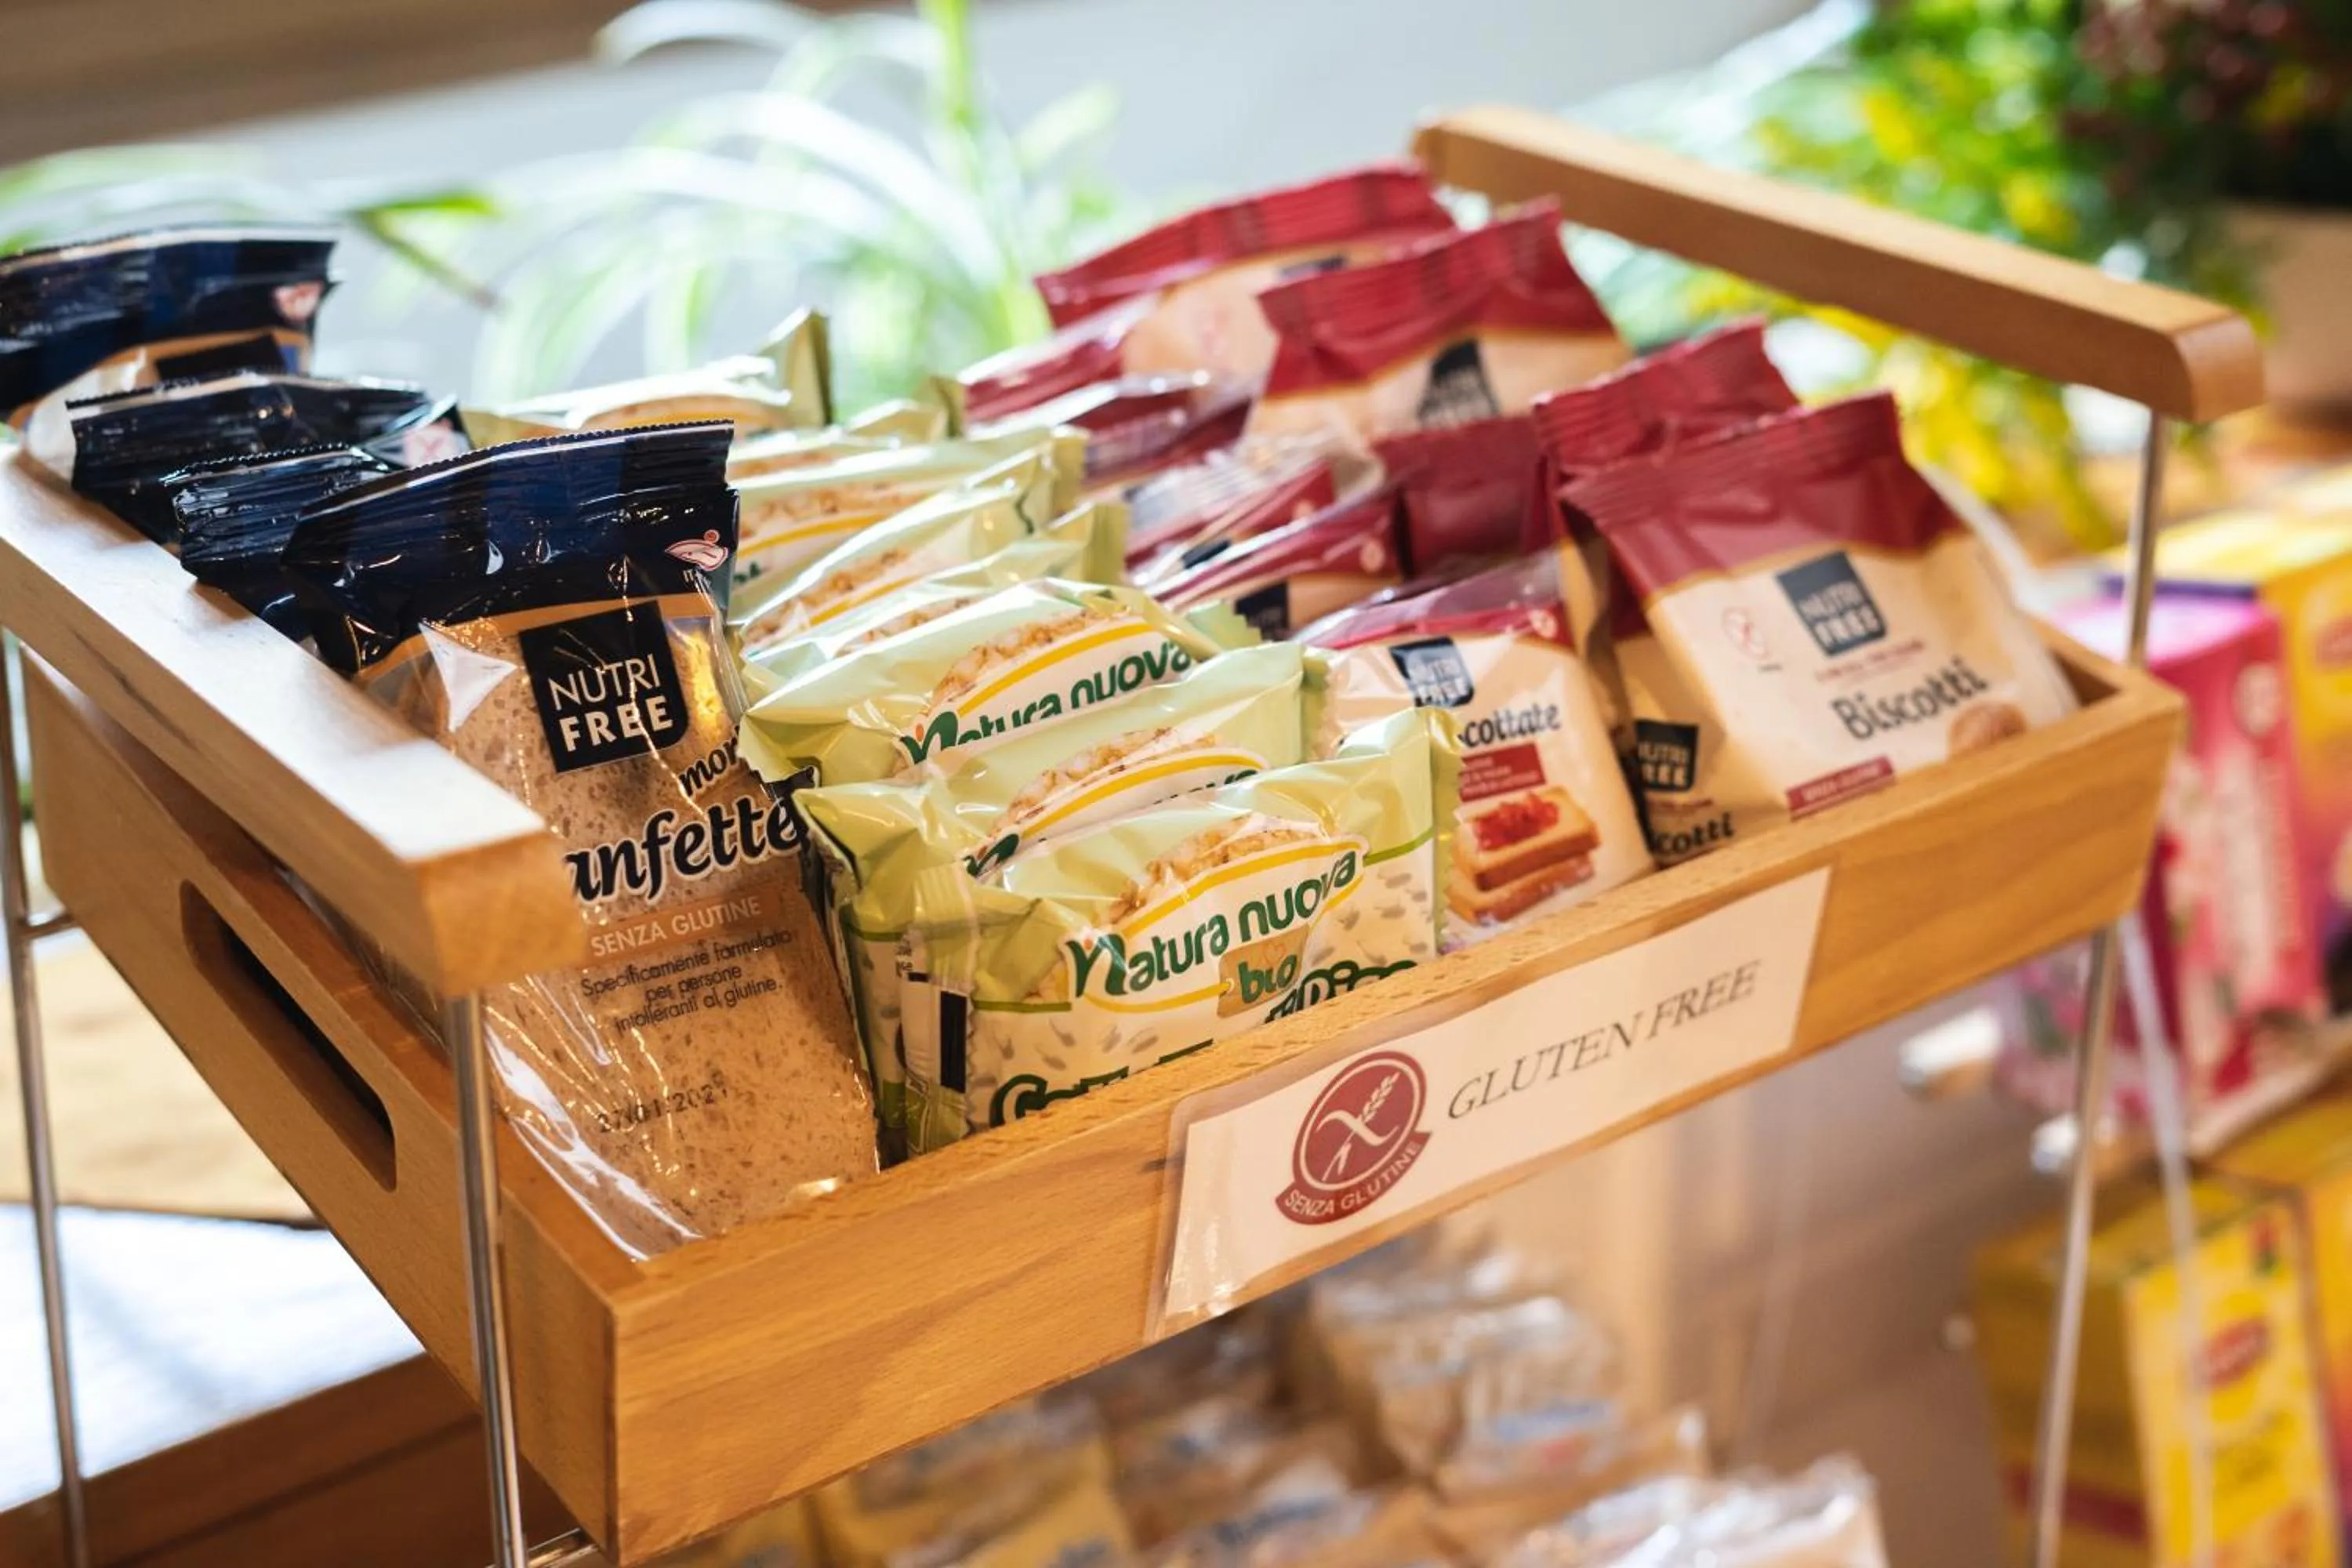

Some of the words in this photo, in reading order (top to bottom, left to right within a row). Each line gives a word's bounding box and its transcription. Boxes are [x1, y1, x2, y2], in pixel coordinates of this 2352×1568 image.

[547, 653, 661, 711] NUTRI
[1069, 641, 1192, 710] nuova
[1831, 656, 1988, 739] Biscotti
[559, 695, 673, 753] FREE
[1458, 703, 1562, 748] cottate
[679, 726, 740, 797] mor
[564, 797, 803, 901] anfette
[1653, 811, 1735, 855] cotti
[590, 922, 668, 957] SENZA
[672, 896, 763, 936] GLUTINE
[1066, 913, 1229, 998] Natura
[1238, 851, 1356, 943] nuova
[580, 946, 711, 1005] Specificamente
[645, 984, 673, 1004] per
[677, 964, 742, 997] persone
[702, 986, 722, 1009] al
[1238, 953, 1298, 1004] bio
[1446, 1011, 1644, 1120] GLUTEN
[1646, 958, 1761, 1040] FREE
[1284, 1189, 1335, 1217] SENZA
[1340, 1140, 1424, 1210] GLUTINE
